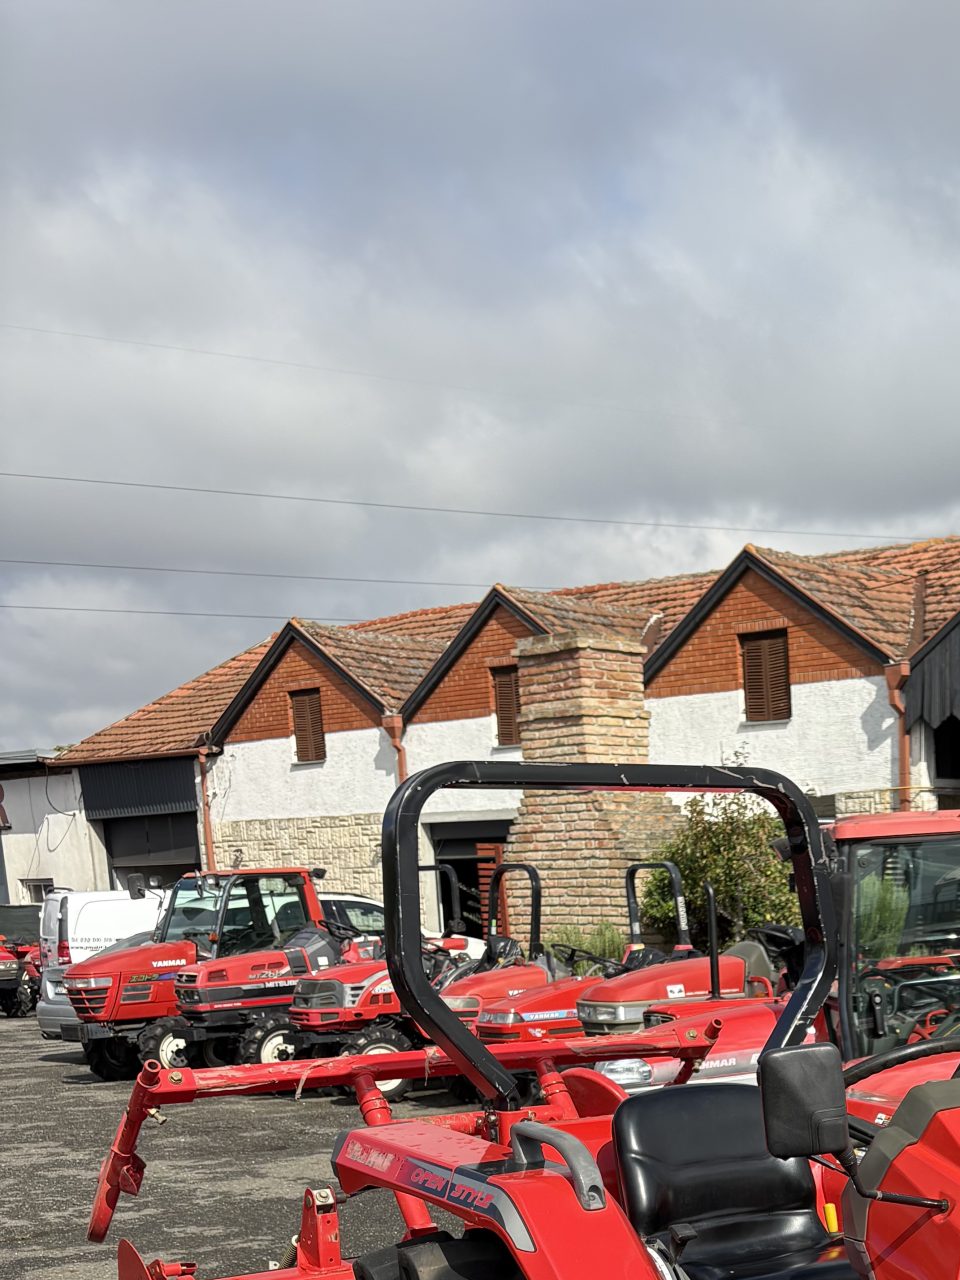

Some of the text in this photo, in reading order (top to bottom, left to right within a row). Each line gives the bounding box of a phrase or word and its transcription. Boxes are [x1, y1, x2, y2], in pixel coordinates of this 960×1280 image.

[151, 958, 187, 968] YANMAR
[410, 1168, 495, 1209] OPEN STYLE
